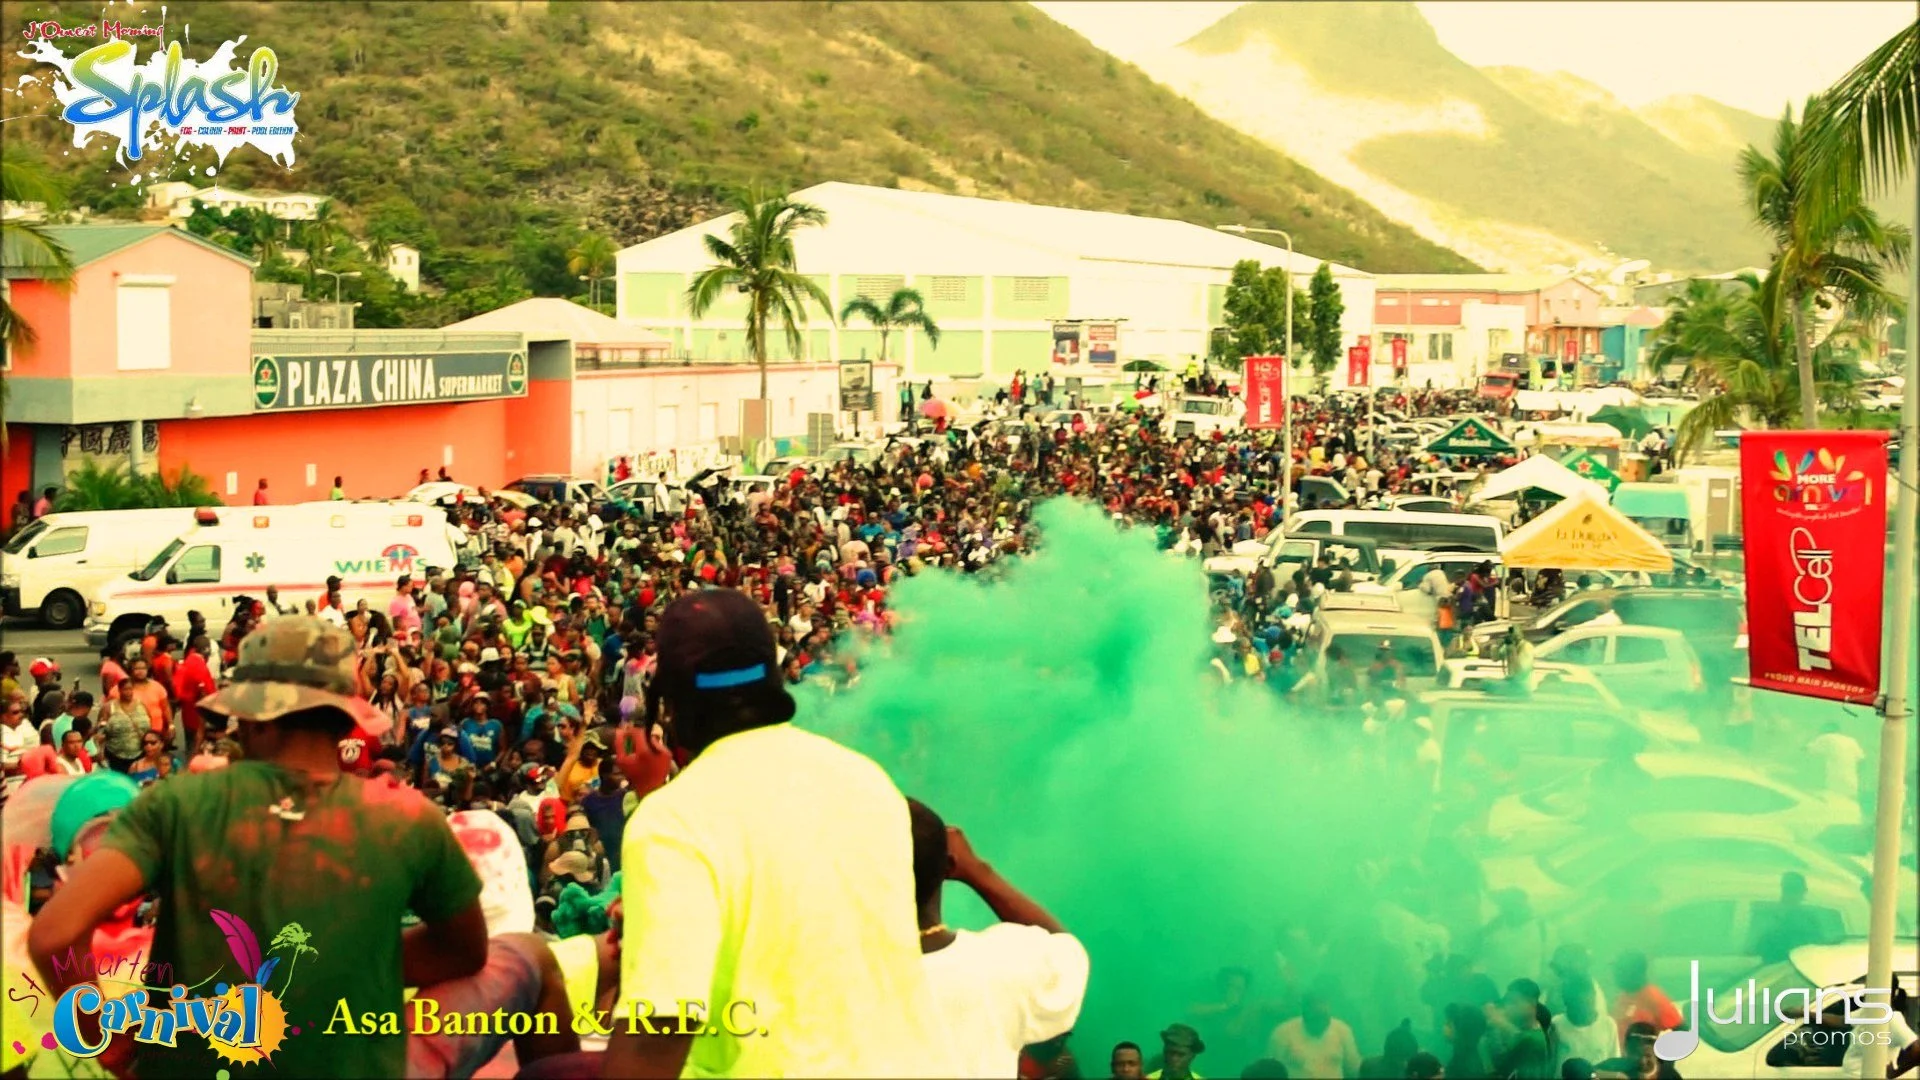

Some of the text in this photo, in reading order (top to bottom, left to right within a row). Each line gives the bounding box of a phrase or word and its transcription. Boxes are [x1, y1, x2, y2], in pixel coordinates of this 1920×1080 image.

[288, 358, 504, 406] PLAZA CHINA SUPERMARKET
[1797, 474, 1836, 484] MORE
[335, 557, 427, 573] WIEMS
[1797, 676, 1820, 686] MAIN
[1822, 680, 1865, 693] SPONSOR
